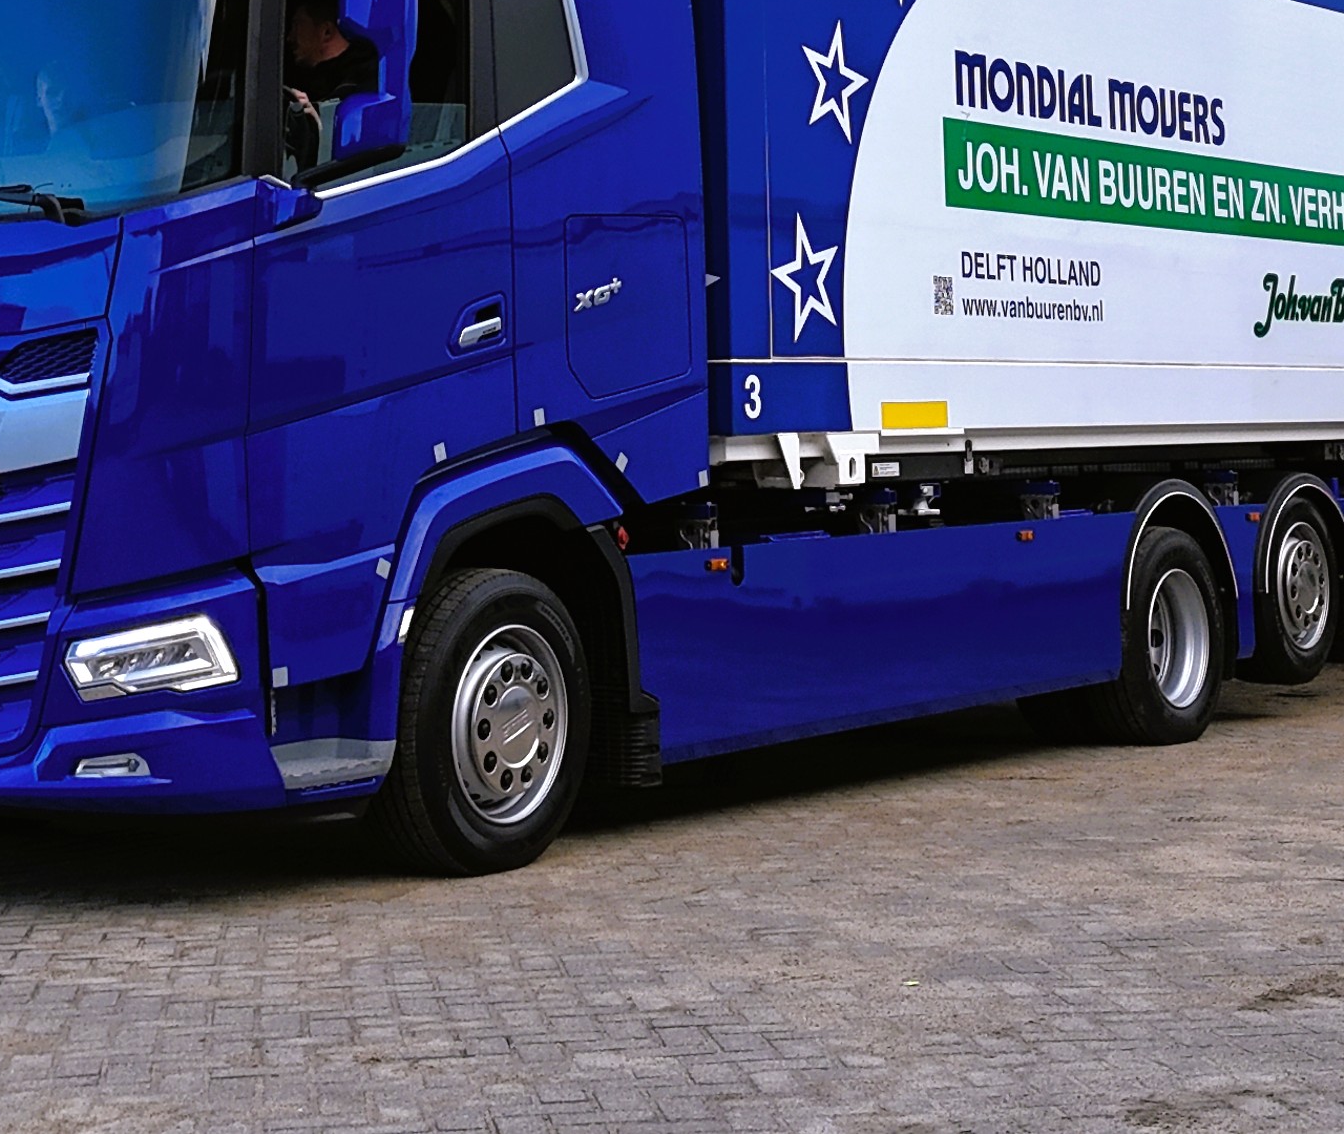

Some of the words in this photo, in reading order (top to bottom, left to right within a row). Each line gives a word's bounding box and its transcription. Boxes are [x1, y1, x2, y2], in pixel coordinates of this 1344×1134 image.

[955, 50, 1102, 128] MONDIAL
[1108, 78, 1226, 146] MOVERS
[958, 141, 1029, 196] JOH.
[1033, 151, 1091, 203] VAN
[1098, 159, 1206, 216] BUUREN
[1212, 174, 1244, 220] EN
[1250, 180, 1286, 224] ZN.
[961, 251, 1017, 281] DELFT
[1022, 256, 1101, 287] HOLLAND
[962, 296, 1104, 322] www.vanbuurenbv.nl
[744, 374, 761, 419] 3
